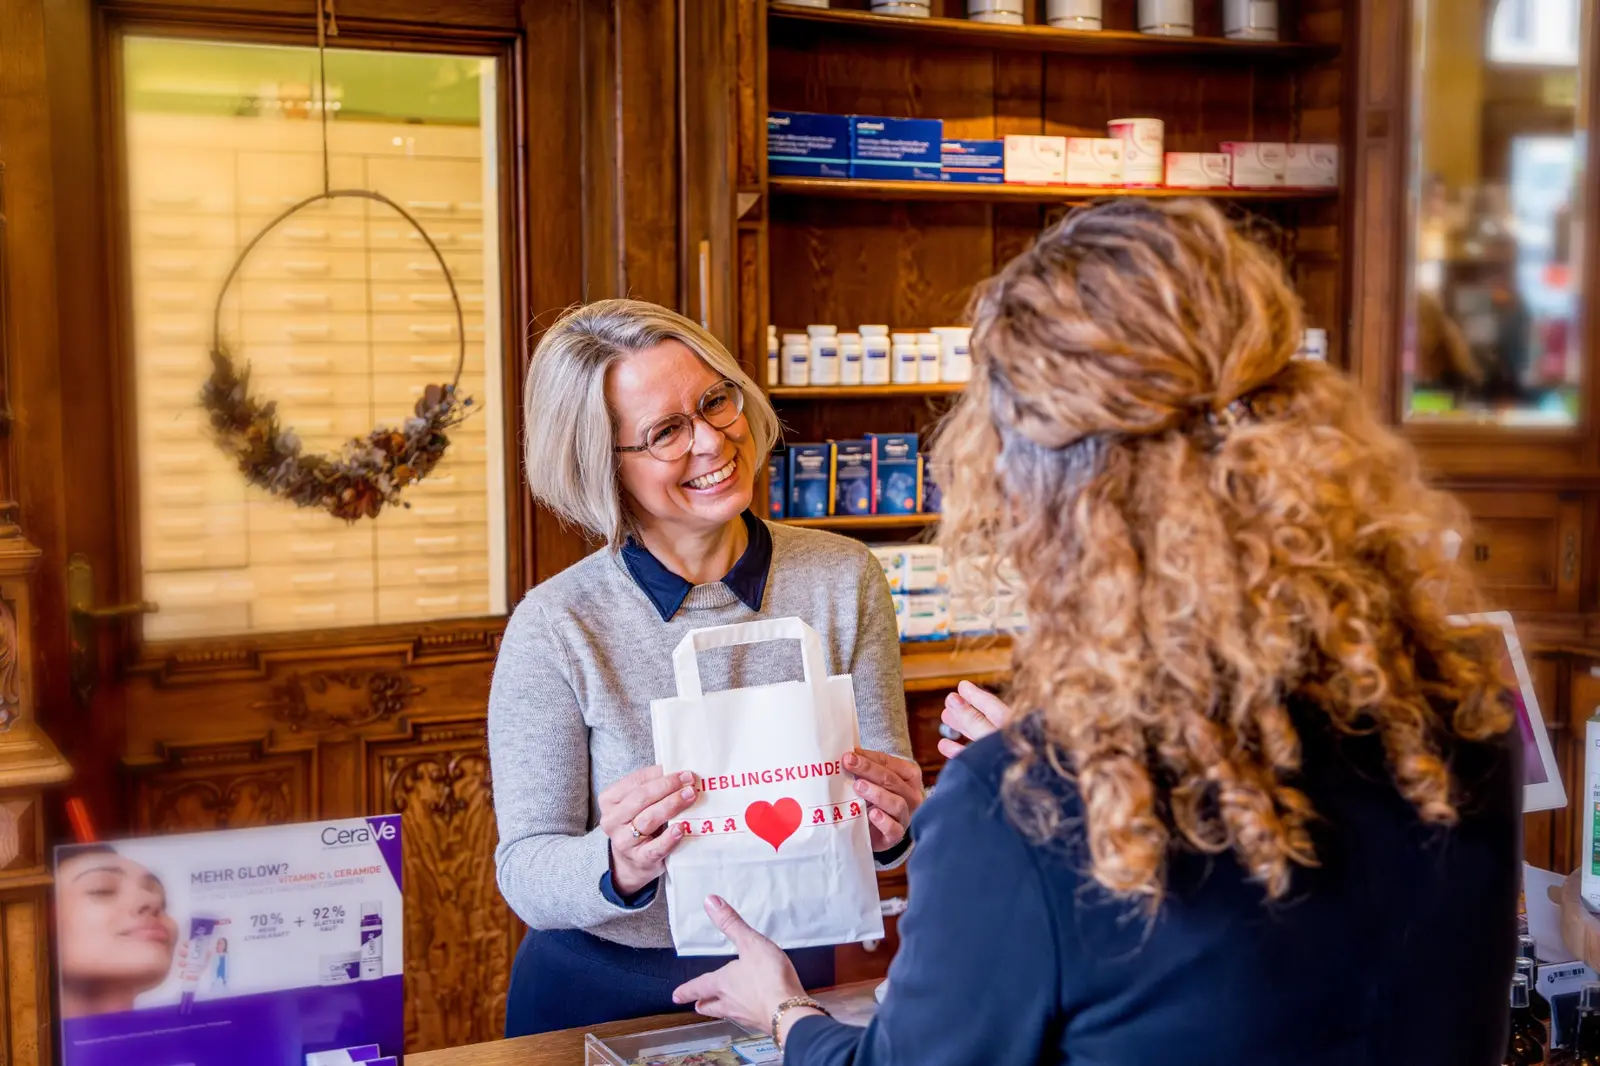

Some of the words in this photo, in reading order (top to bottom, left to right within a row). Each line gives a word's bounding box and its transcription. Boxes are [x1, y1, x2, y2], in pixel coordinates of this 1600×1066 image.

[696, 761, 840, 792] IEBLINGSKUNDE
[321, 821, 396, 846] CeraVe
[190, 869, 234, 885] MEHR
[238, 863, 289, 880] GLOW?
[279, 872, 317, 884] VITAMIN
[334, 865, 382, 879] CERAMIDE
